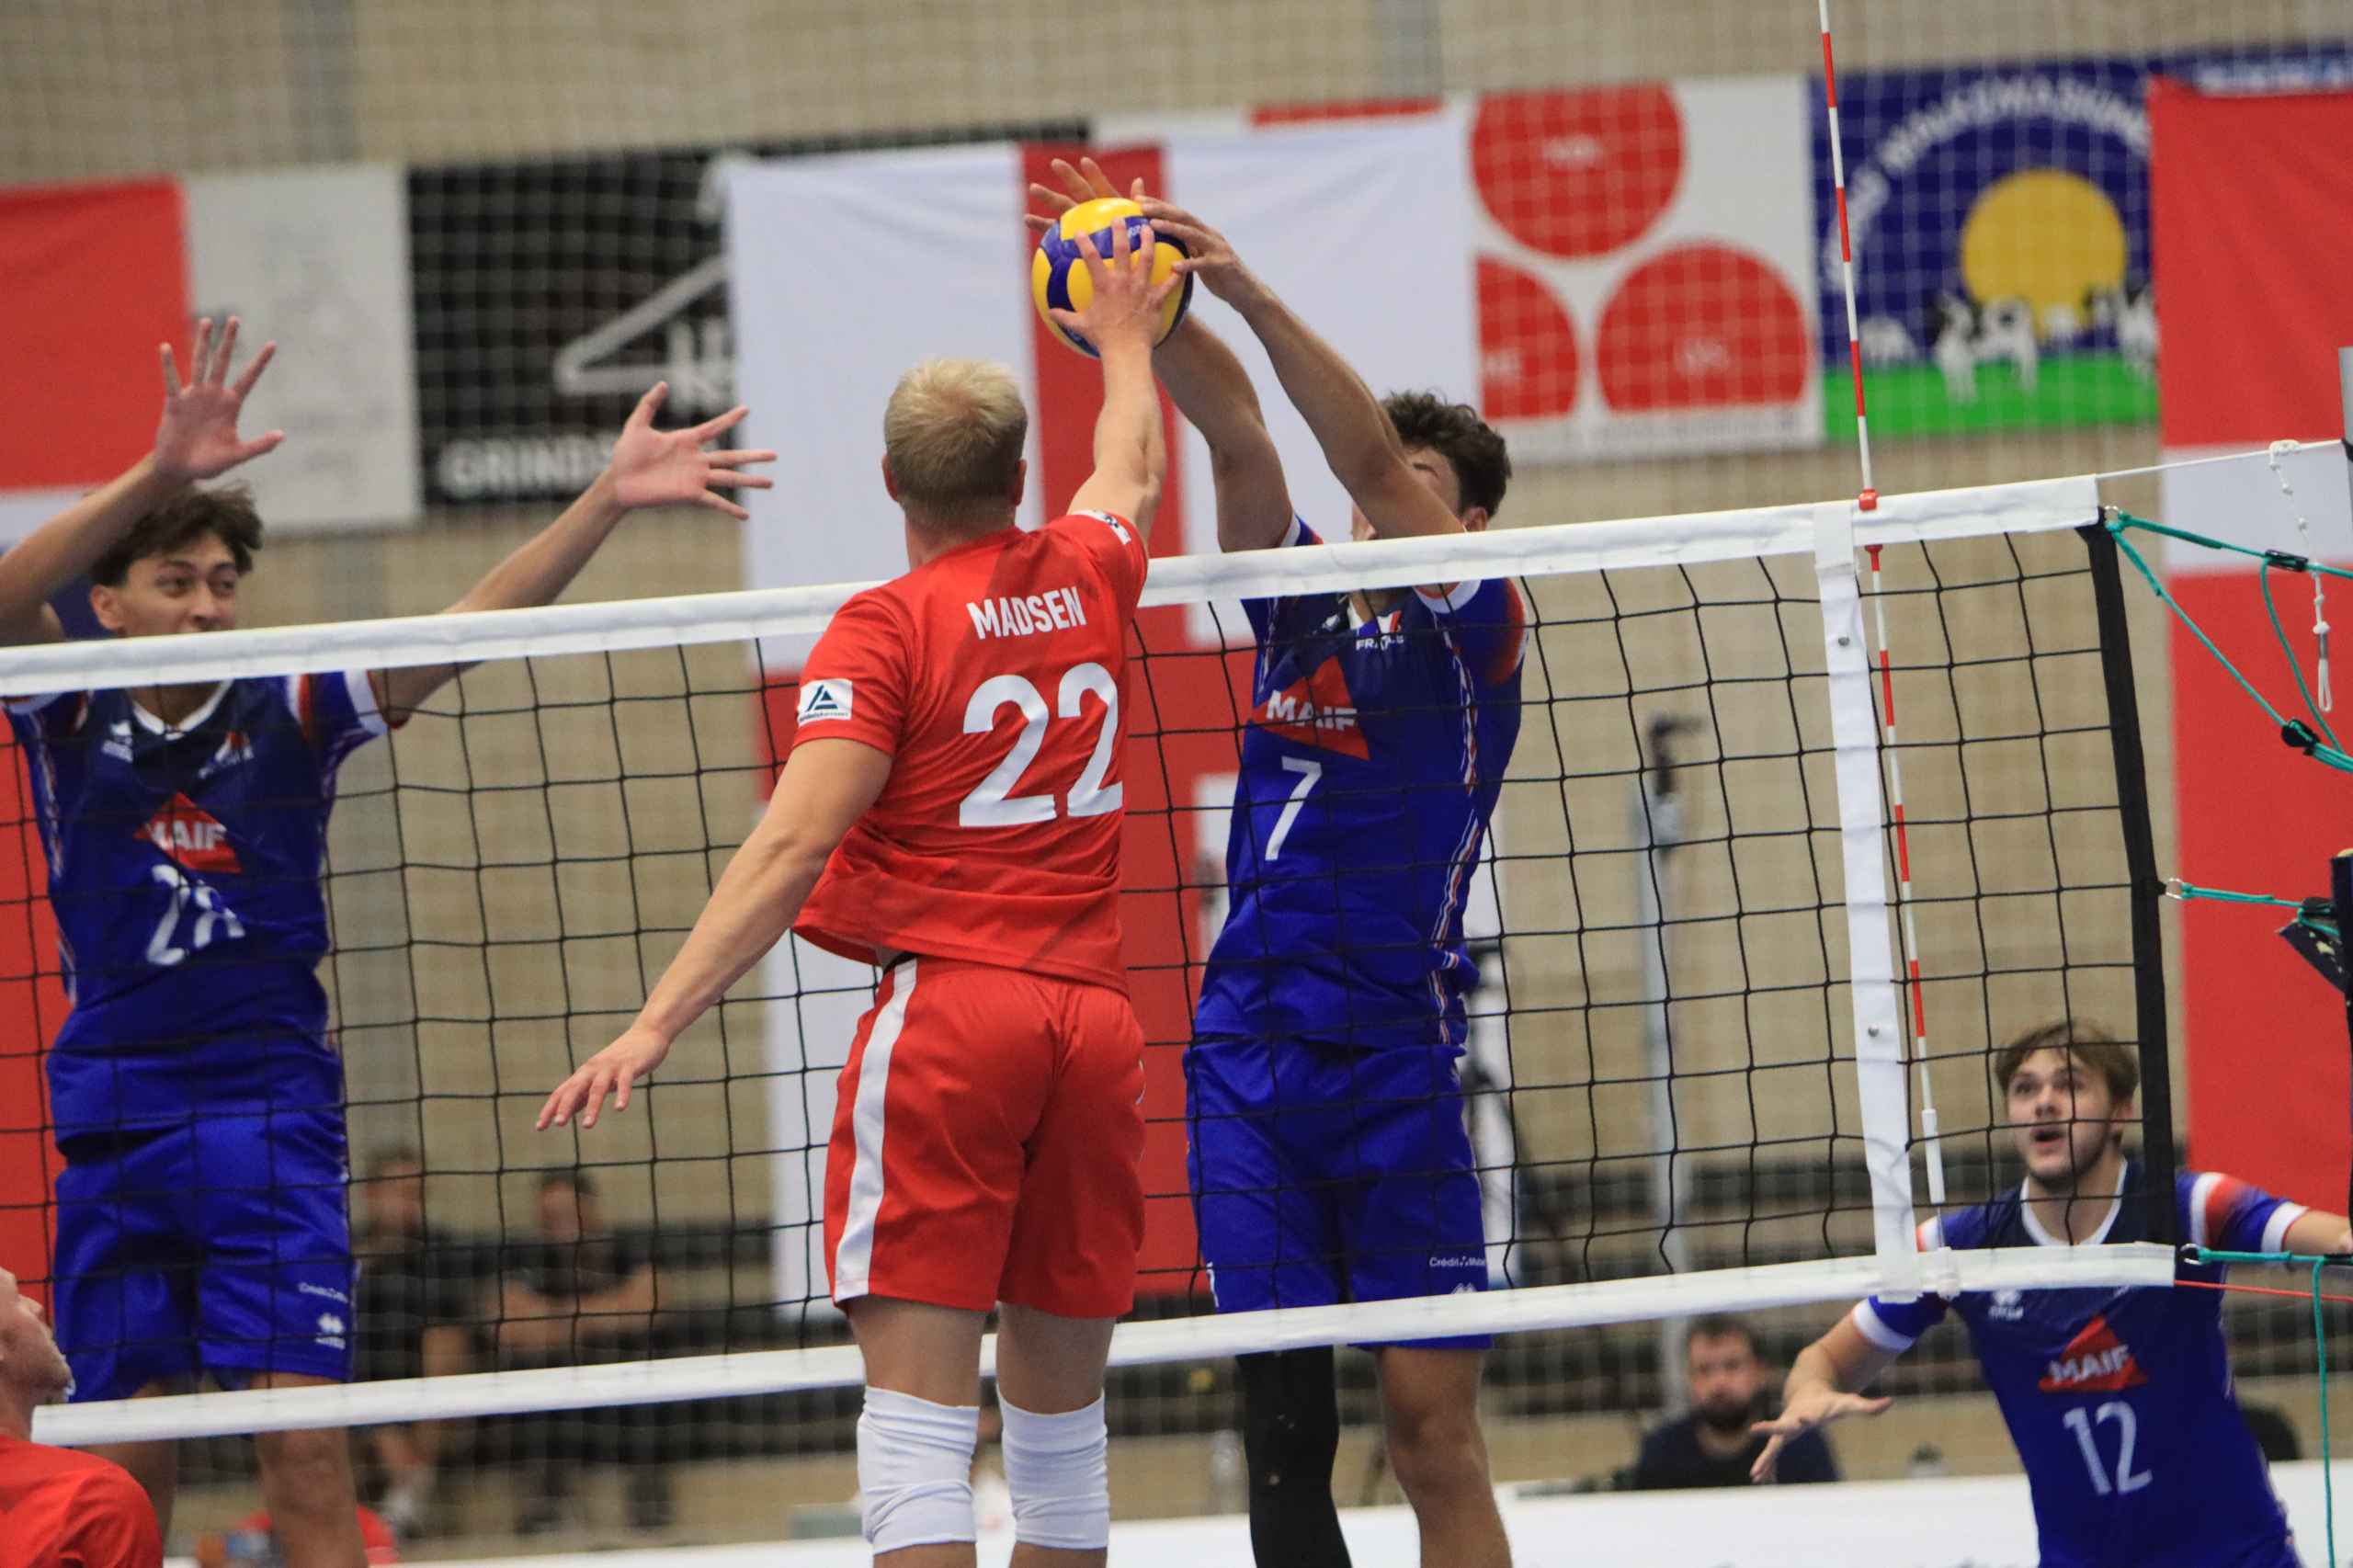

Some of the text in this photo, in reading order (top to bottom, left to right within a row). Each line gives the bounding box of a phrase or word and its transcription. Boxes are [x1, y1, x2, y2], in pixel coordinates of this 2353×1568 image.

[966, 586, 1088, 640] MADSEN
[959, 662, 1123, 828] 22
[1266, 689, 1358, 731] MAIF
[1265, 756, 1323, 861] 7
[2048, 1344, 2130, 1383] MAIF
[2062, 1400, 2154, 1496] 12
